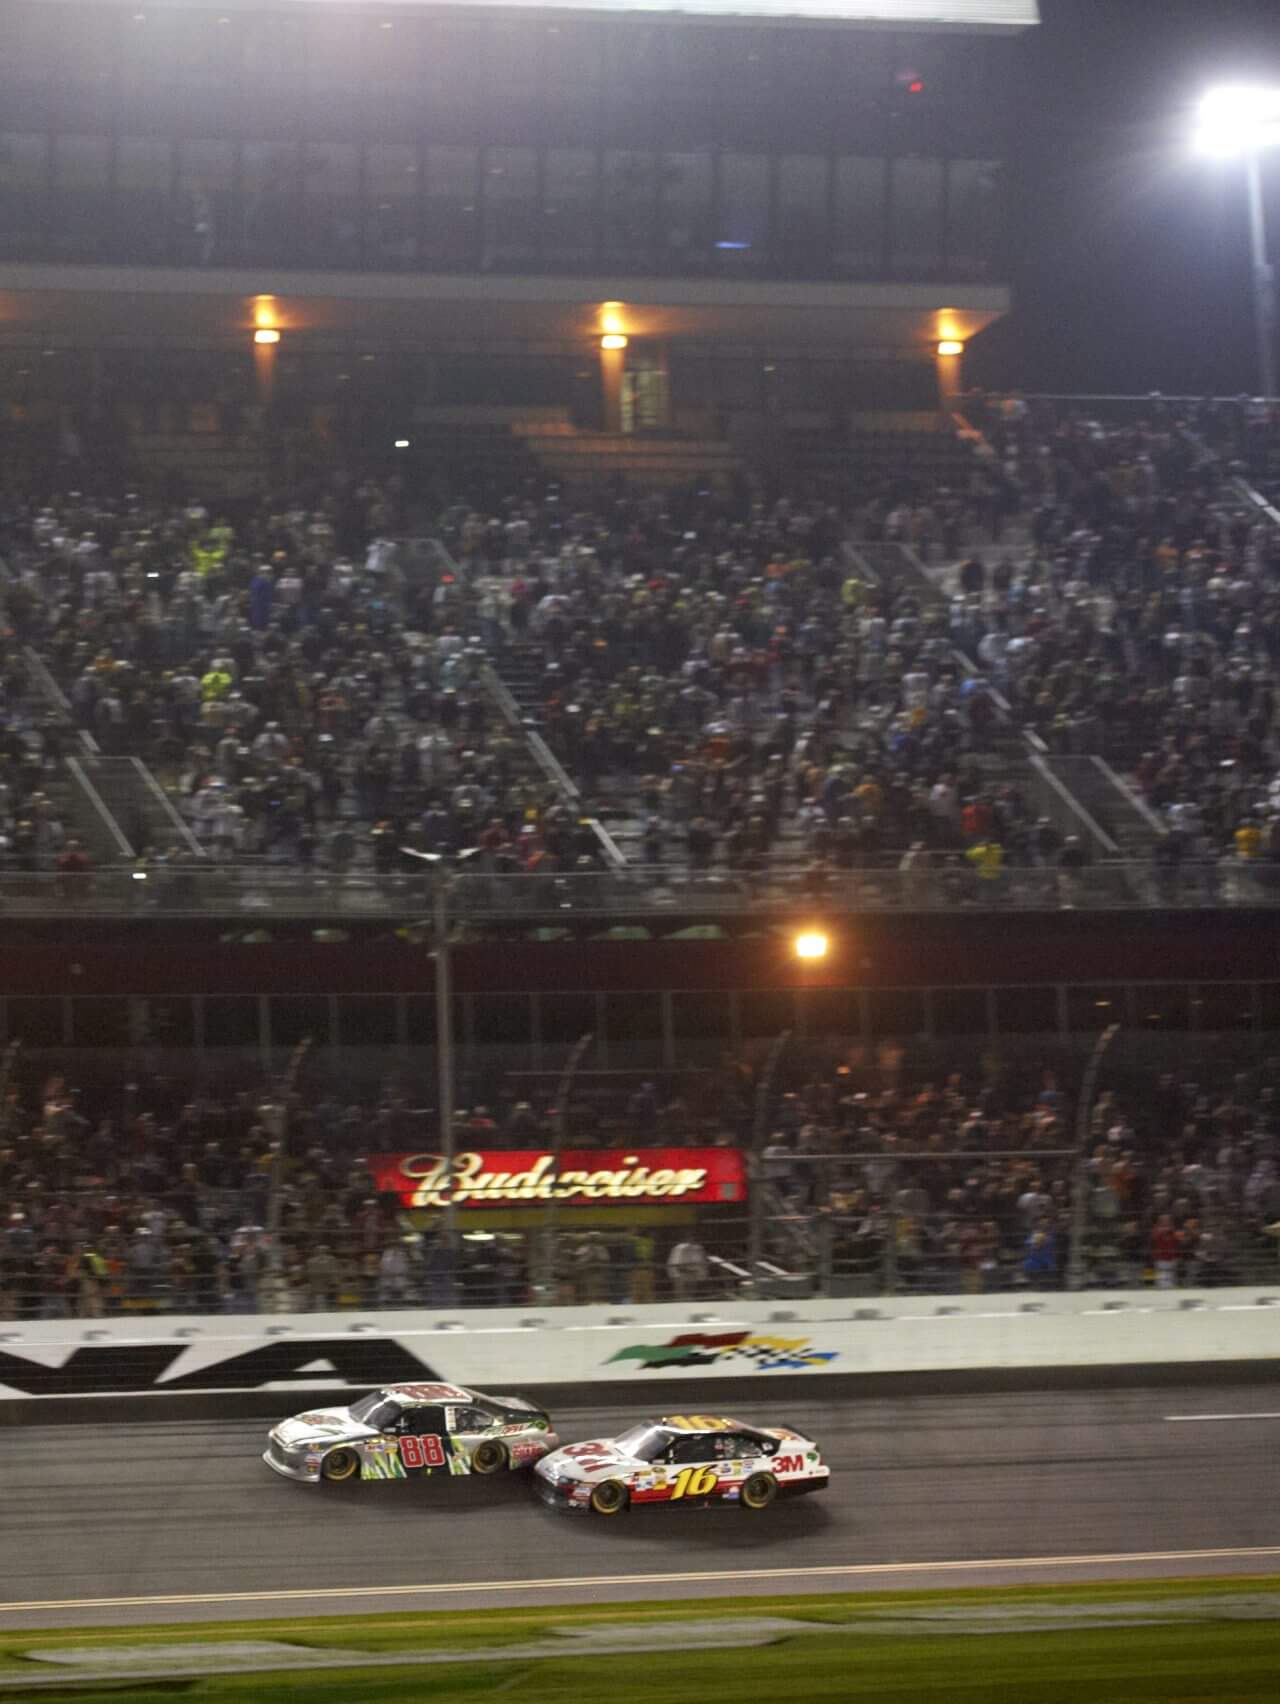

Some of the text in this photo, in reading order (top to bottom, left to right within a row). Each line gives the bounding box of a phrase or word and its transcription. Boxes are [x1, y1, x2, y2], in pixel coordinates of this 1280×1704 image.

[399, 1433, 445, 1468] 88
[770, 1454, 804, 1474] 3M
[670, 1464, 719, 1500] 16
